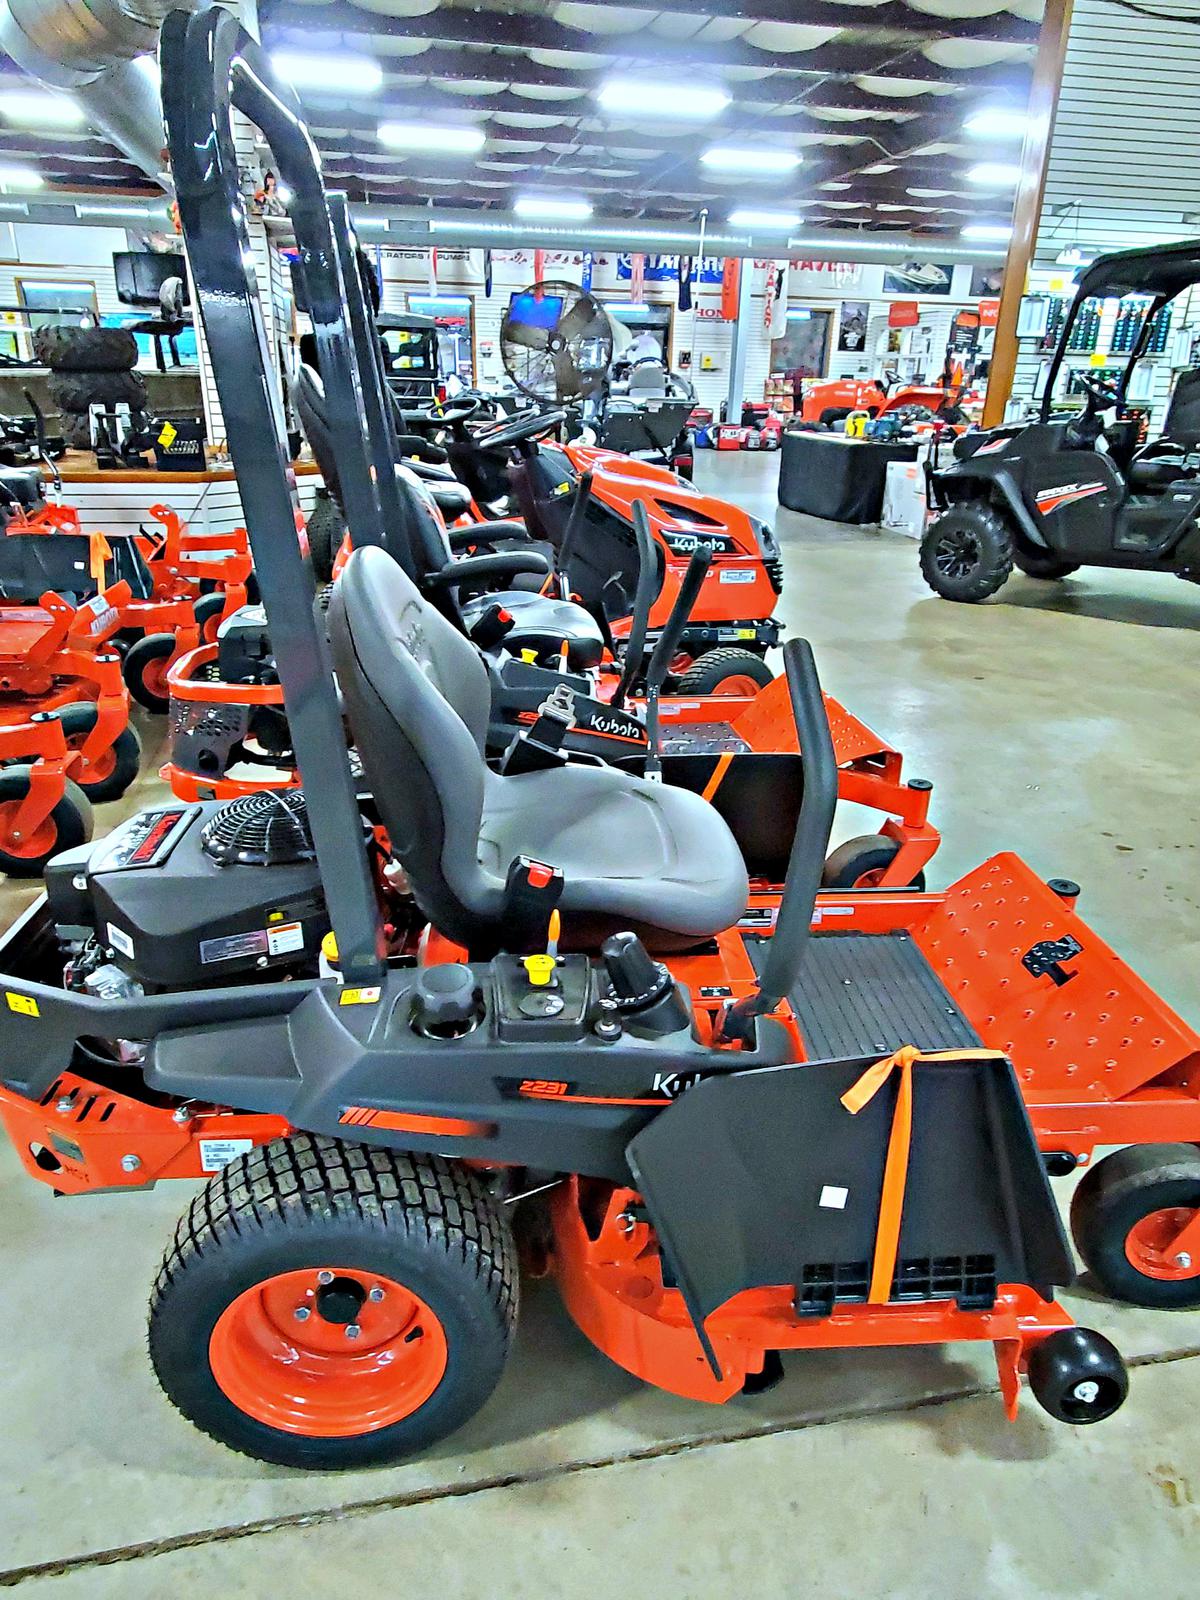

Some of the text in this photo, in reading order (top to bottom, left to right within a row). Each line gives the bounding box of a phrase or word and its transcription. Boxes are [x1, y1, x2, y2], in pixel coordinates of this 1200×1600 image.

[669, 537, 726, 551] Kubota
[590, 714, 640, 739] Kubota
[519, 1080, 568, 1095] Z231
